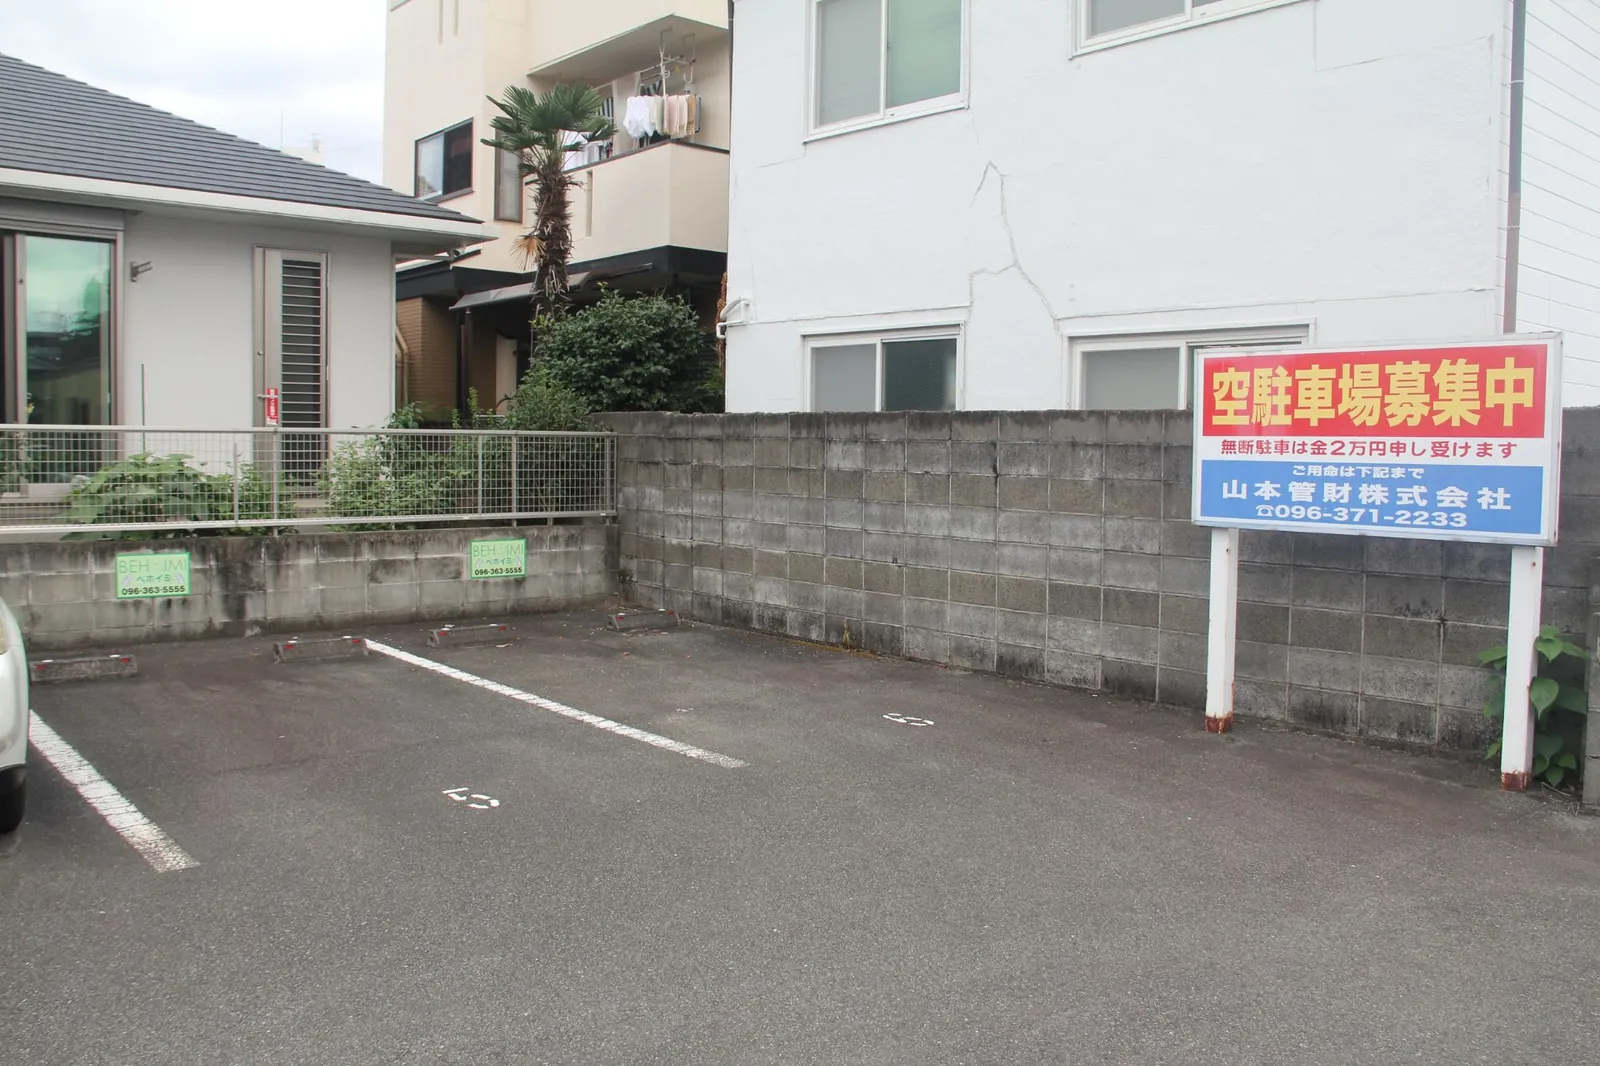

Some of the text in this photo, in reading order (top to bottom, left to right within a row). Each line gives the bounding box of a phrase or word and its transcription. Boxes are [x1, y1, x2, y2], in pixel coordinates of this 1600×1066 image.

[1211, 356, 1535, 427] 空駐車場募集中
[1220, 438, 1517, 458] 無断駐車は金2万円申し受けます
[1292, 465, 1425, 479] ご用命は下記まで
[1222, 479, 1511, 510] 山本管財株式会社
[1274, 504, 1467, 527] 096-371-2233
[474, 567, 523, 575] 096-363-5555
[122, 585, 186, 595] 096-363-5555
[441, 787, 500, 809] 5
